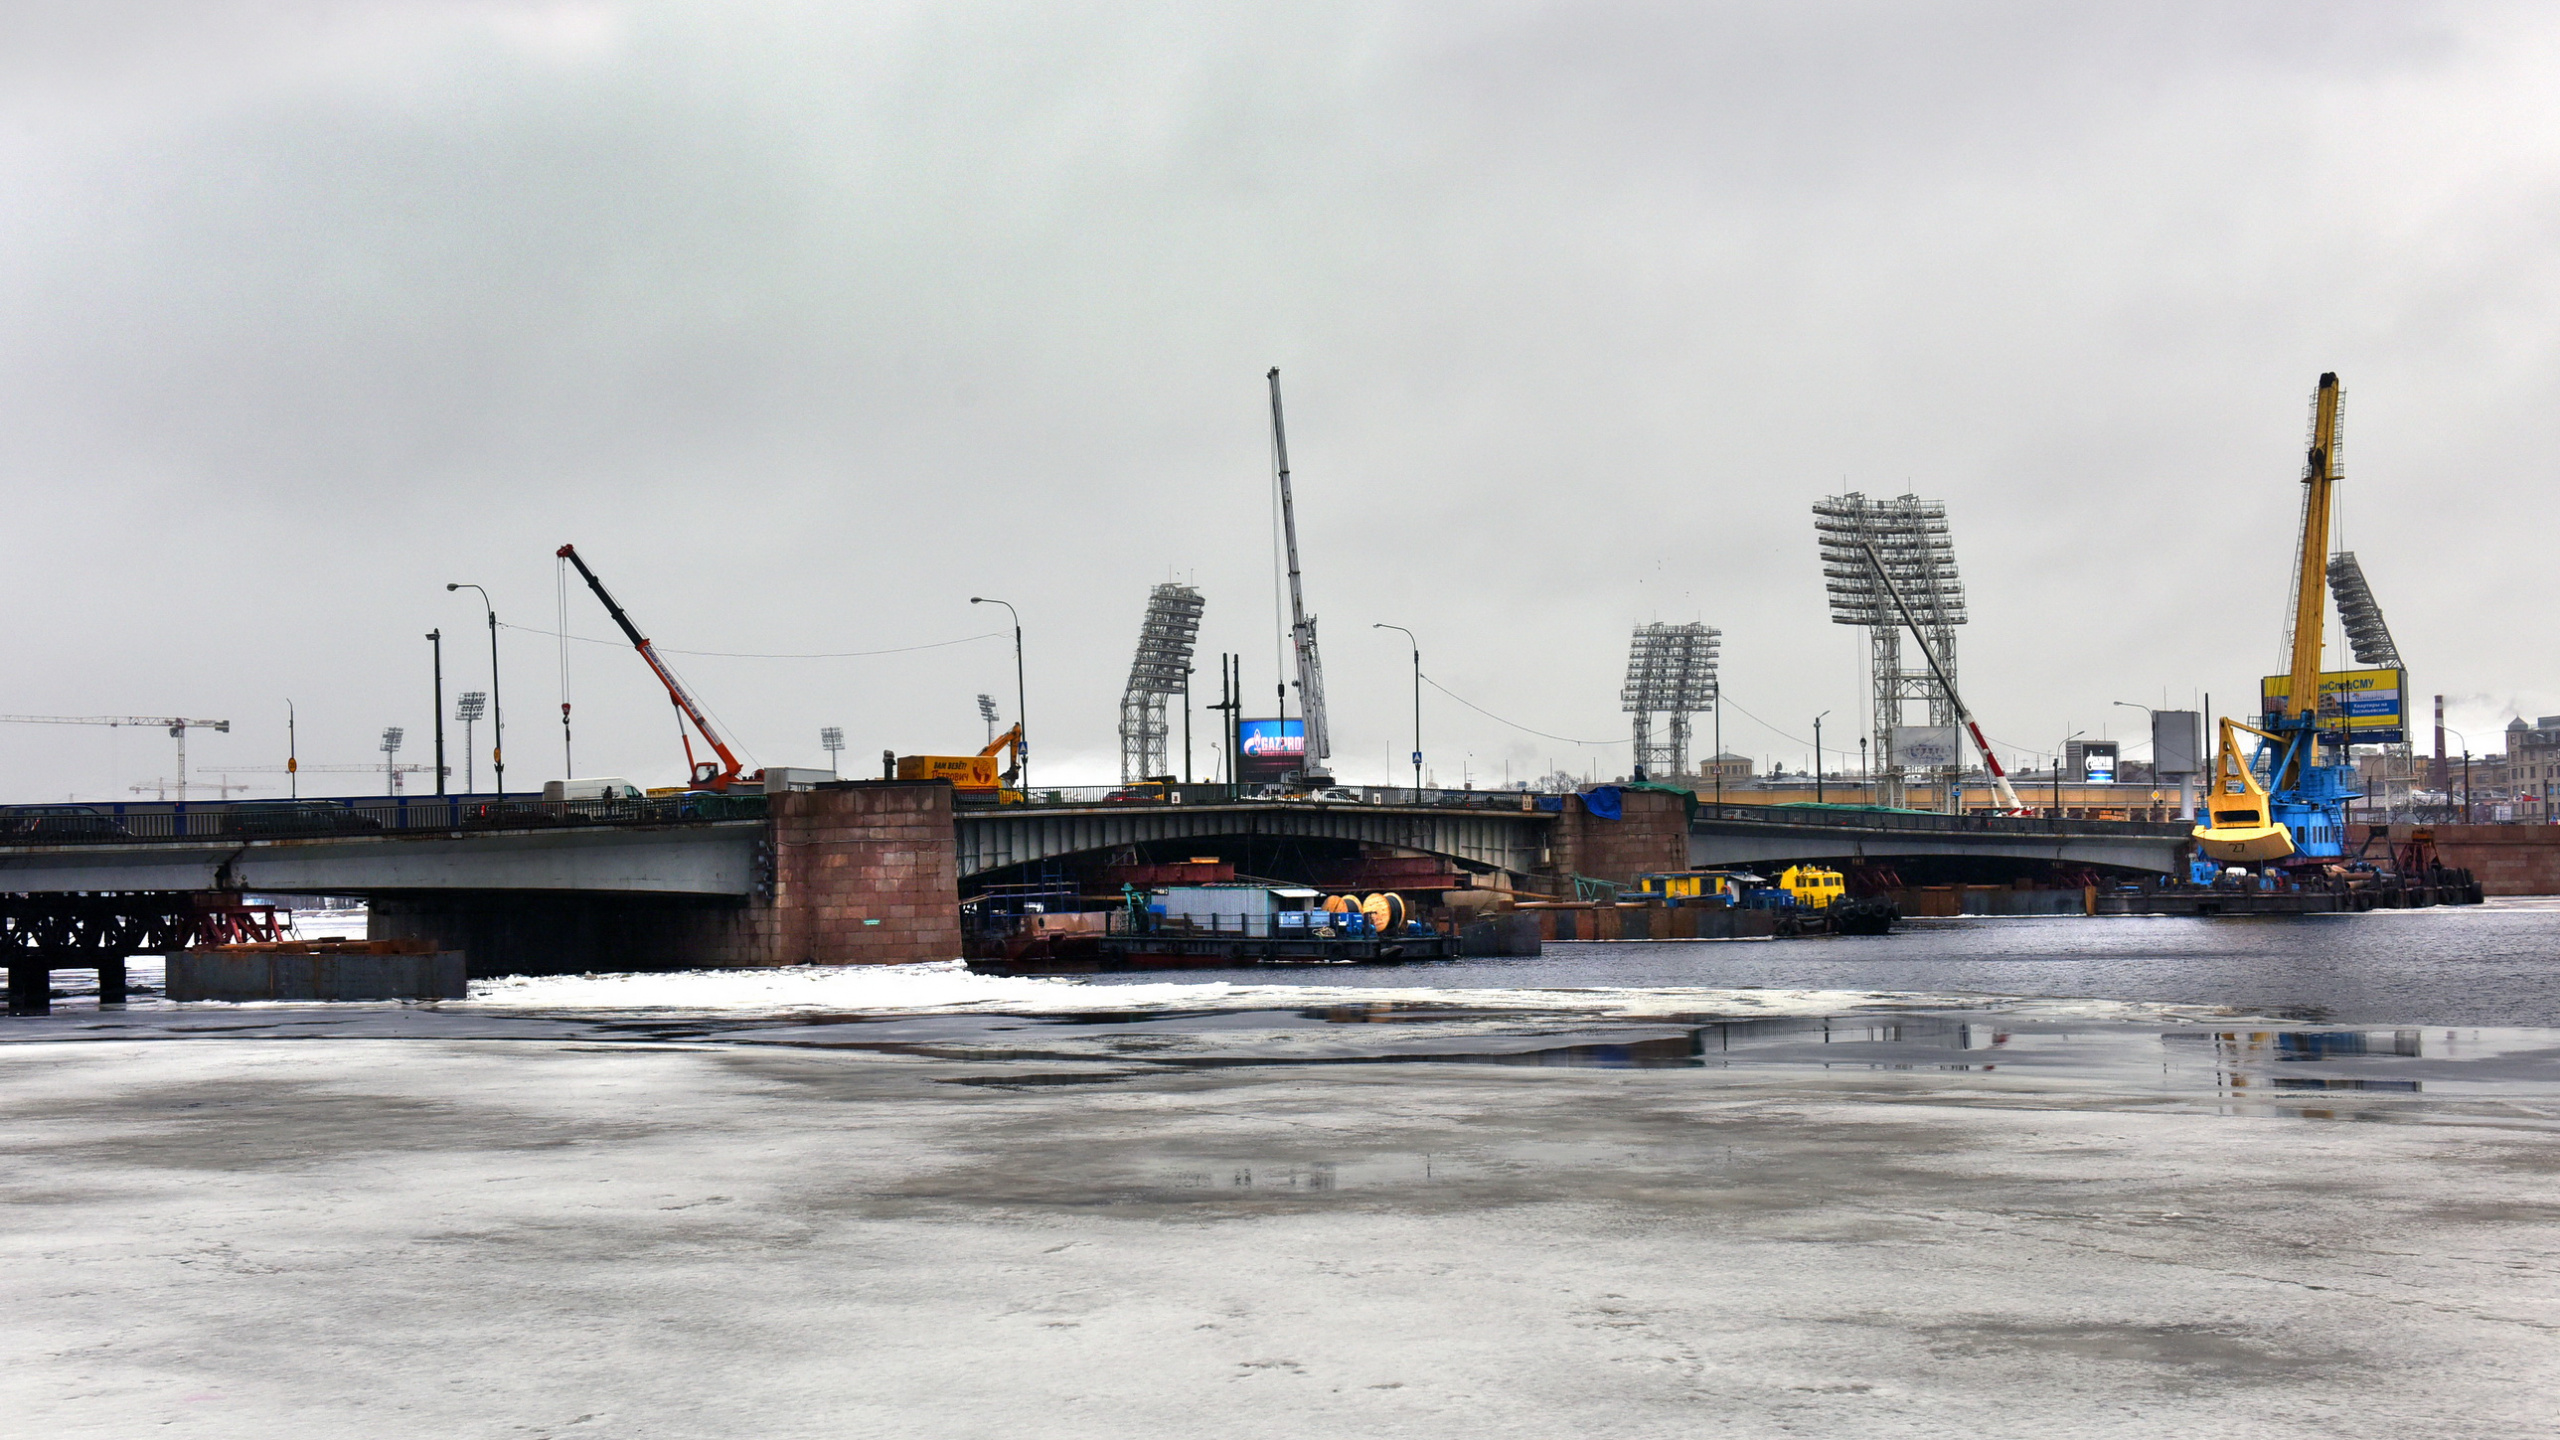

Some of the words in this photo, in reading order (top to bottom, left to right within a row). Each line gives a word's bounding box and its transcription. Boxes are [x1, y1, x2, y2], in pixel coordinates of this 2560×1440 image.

[2318, 678, 2374, 691] енСпецСМУ
[1261, 736, 1304, 751] GAZPRO
[2228, 842, 2245, 853] 27
